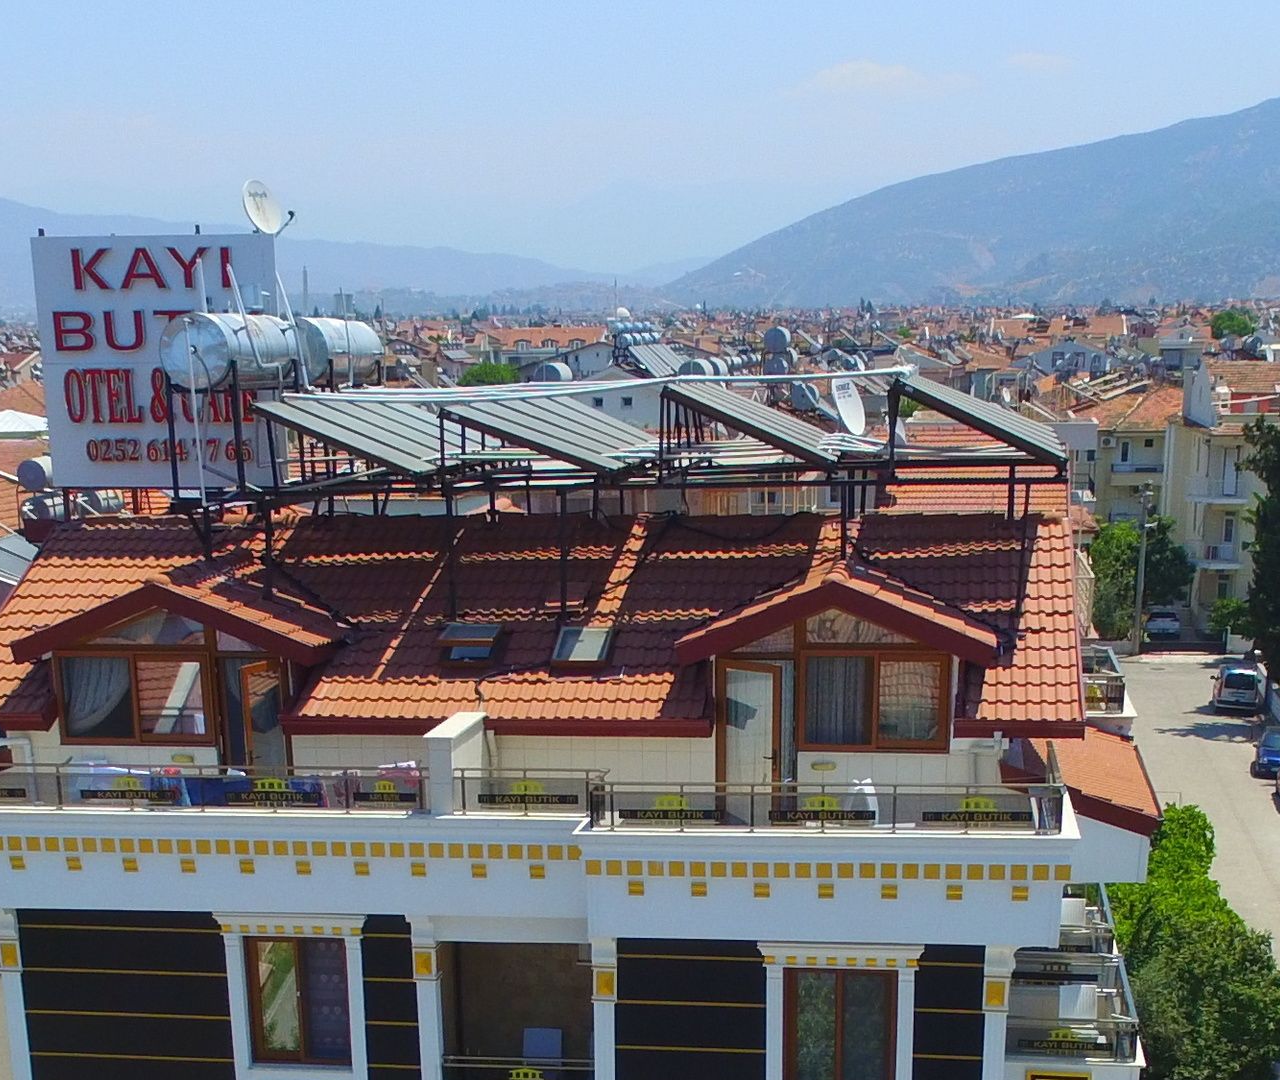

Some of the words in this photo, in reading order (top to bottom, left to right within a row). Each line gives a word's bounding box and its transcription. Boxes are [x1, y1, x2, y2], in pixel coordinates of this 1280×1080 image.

[71, 247, 233, 290] KAYI
[64, 368, 144, 424] OTEL
[150, 368, 169, 424] &
[87, 439, 141, 463] 0252
[147, 439, 189, 463] 614
[636, 811, 664, 819] KAYI
[786, 811, 814, 819] KAYI
[941, 813, 970, 821] KAYI
